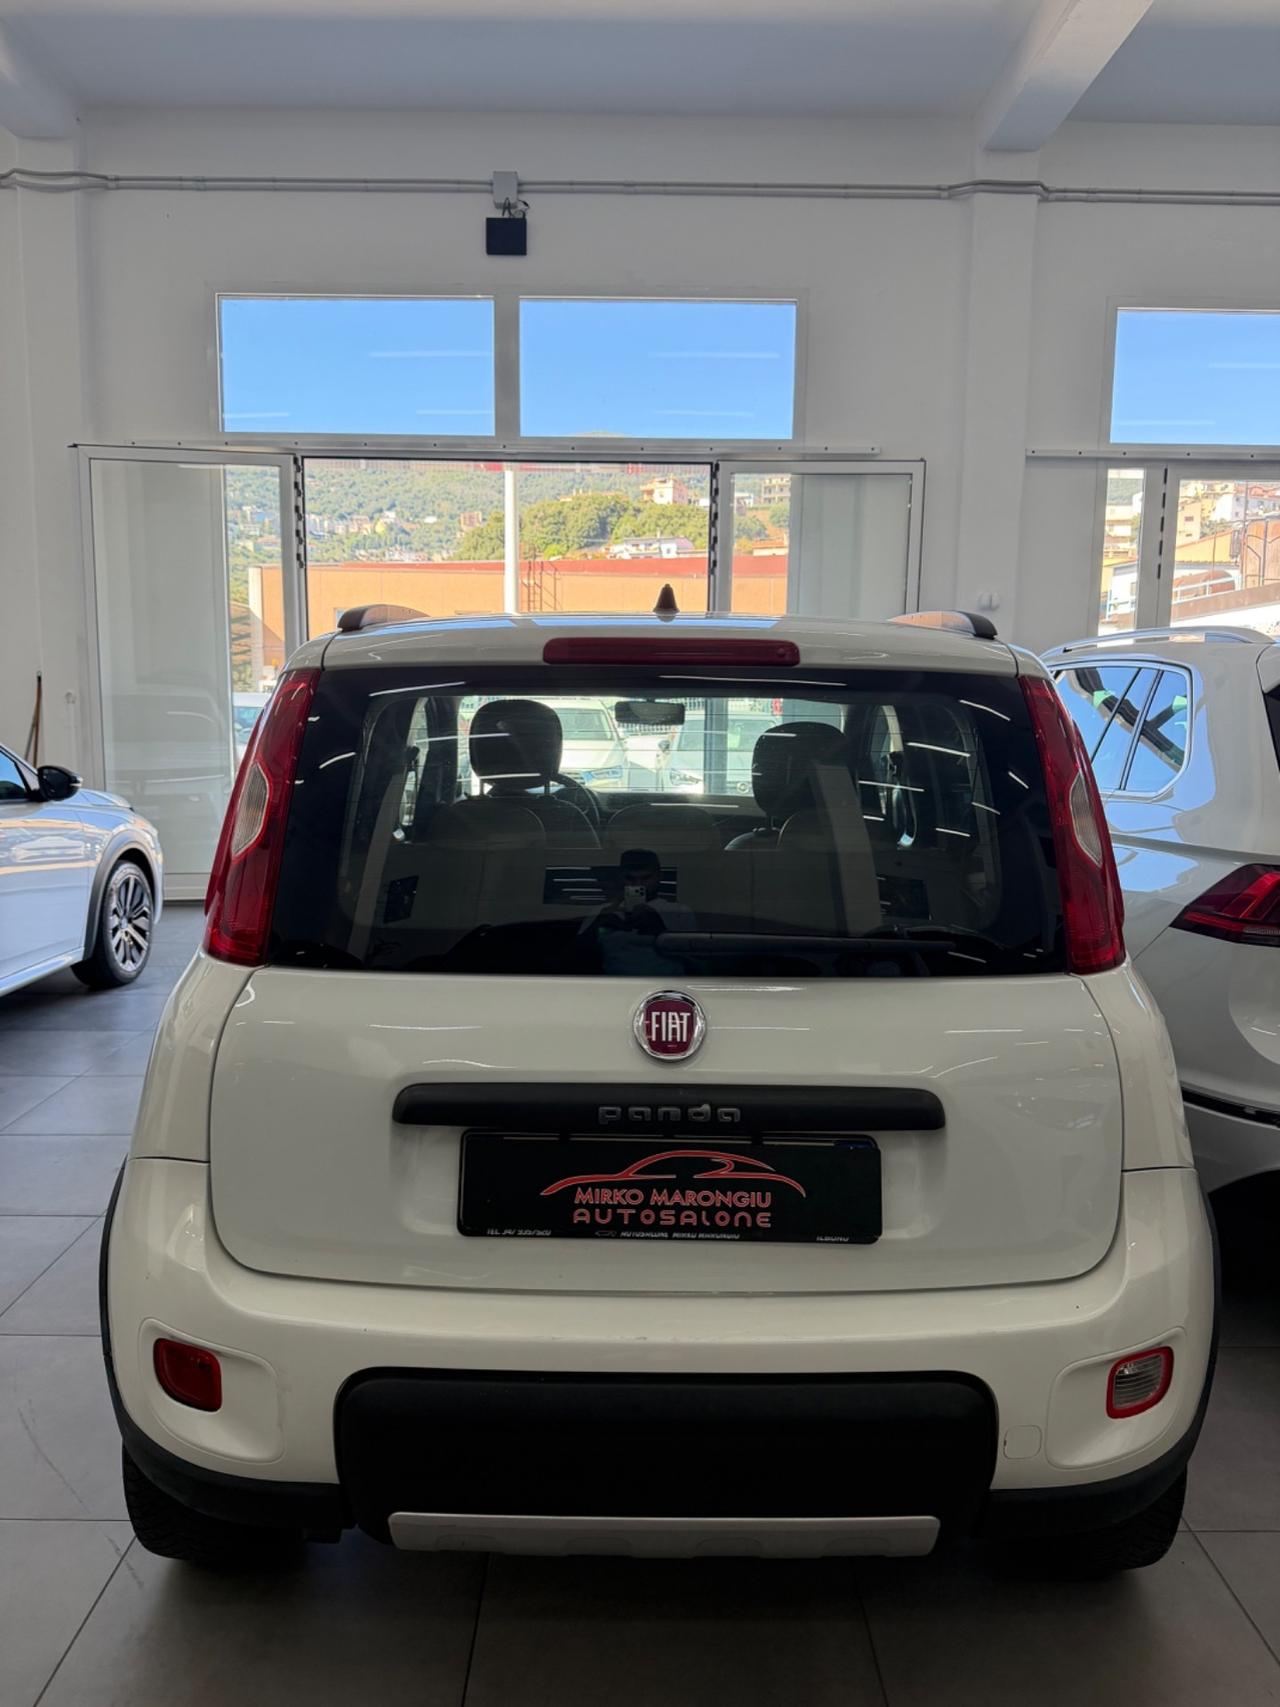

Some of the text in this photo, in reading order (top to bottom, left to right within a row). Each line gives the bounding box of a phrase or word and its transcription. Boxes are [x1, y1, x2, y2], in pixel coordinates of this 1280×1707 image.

[651, 1011, 691, 1042] FIAT
[598, 1103, 741, 1124] panda
[574, 1187, 772, 1208] MIRKO MARONGIU
